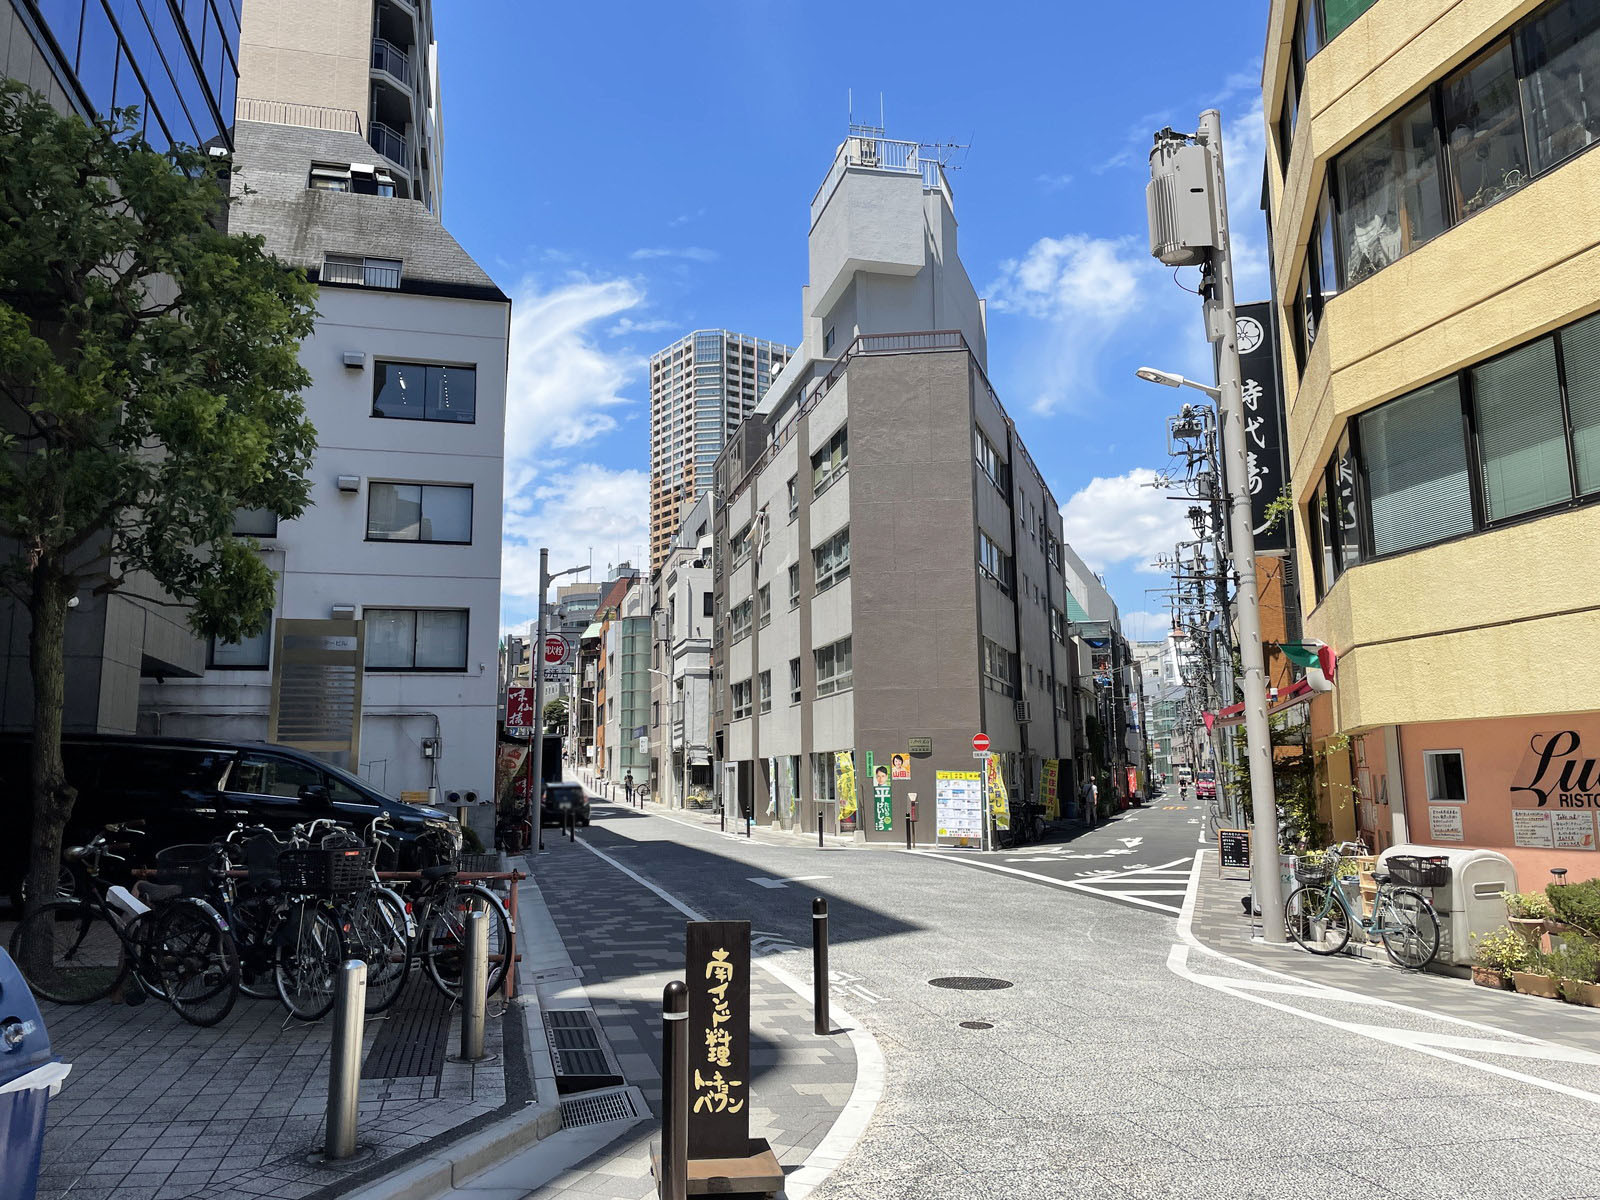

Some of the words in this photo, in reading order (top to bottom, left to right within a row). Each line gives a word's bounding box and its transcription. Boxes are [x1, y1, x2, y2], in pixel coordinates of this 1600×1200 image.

[1510, 730, 1600, 807] Lu
[705, 948, 733, 1067] 南インド料理
[692, 1089, 744, 1114] バワン
[695, 1069, 743, 1093] トーキョー
